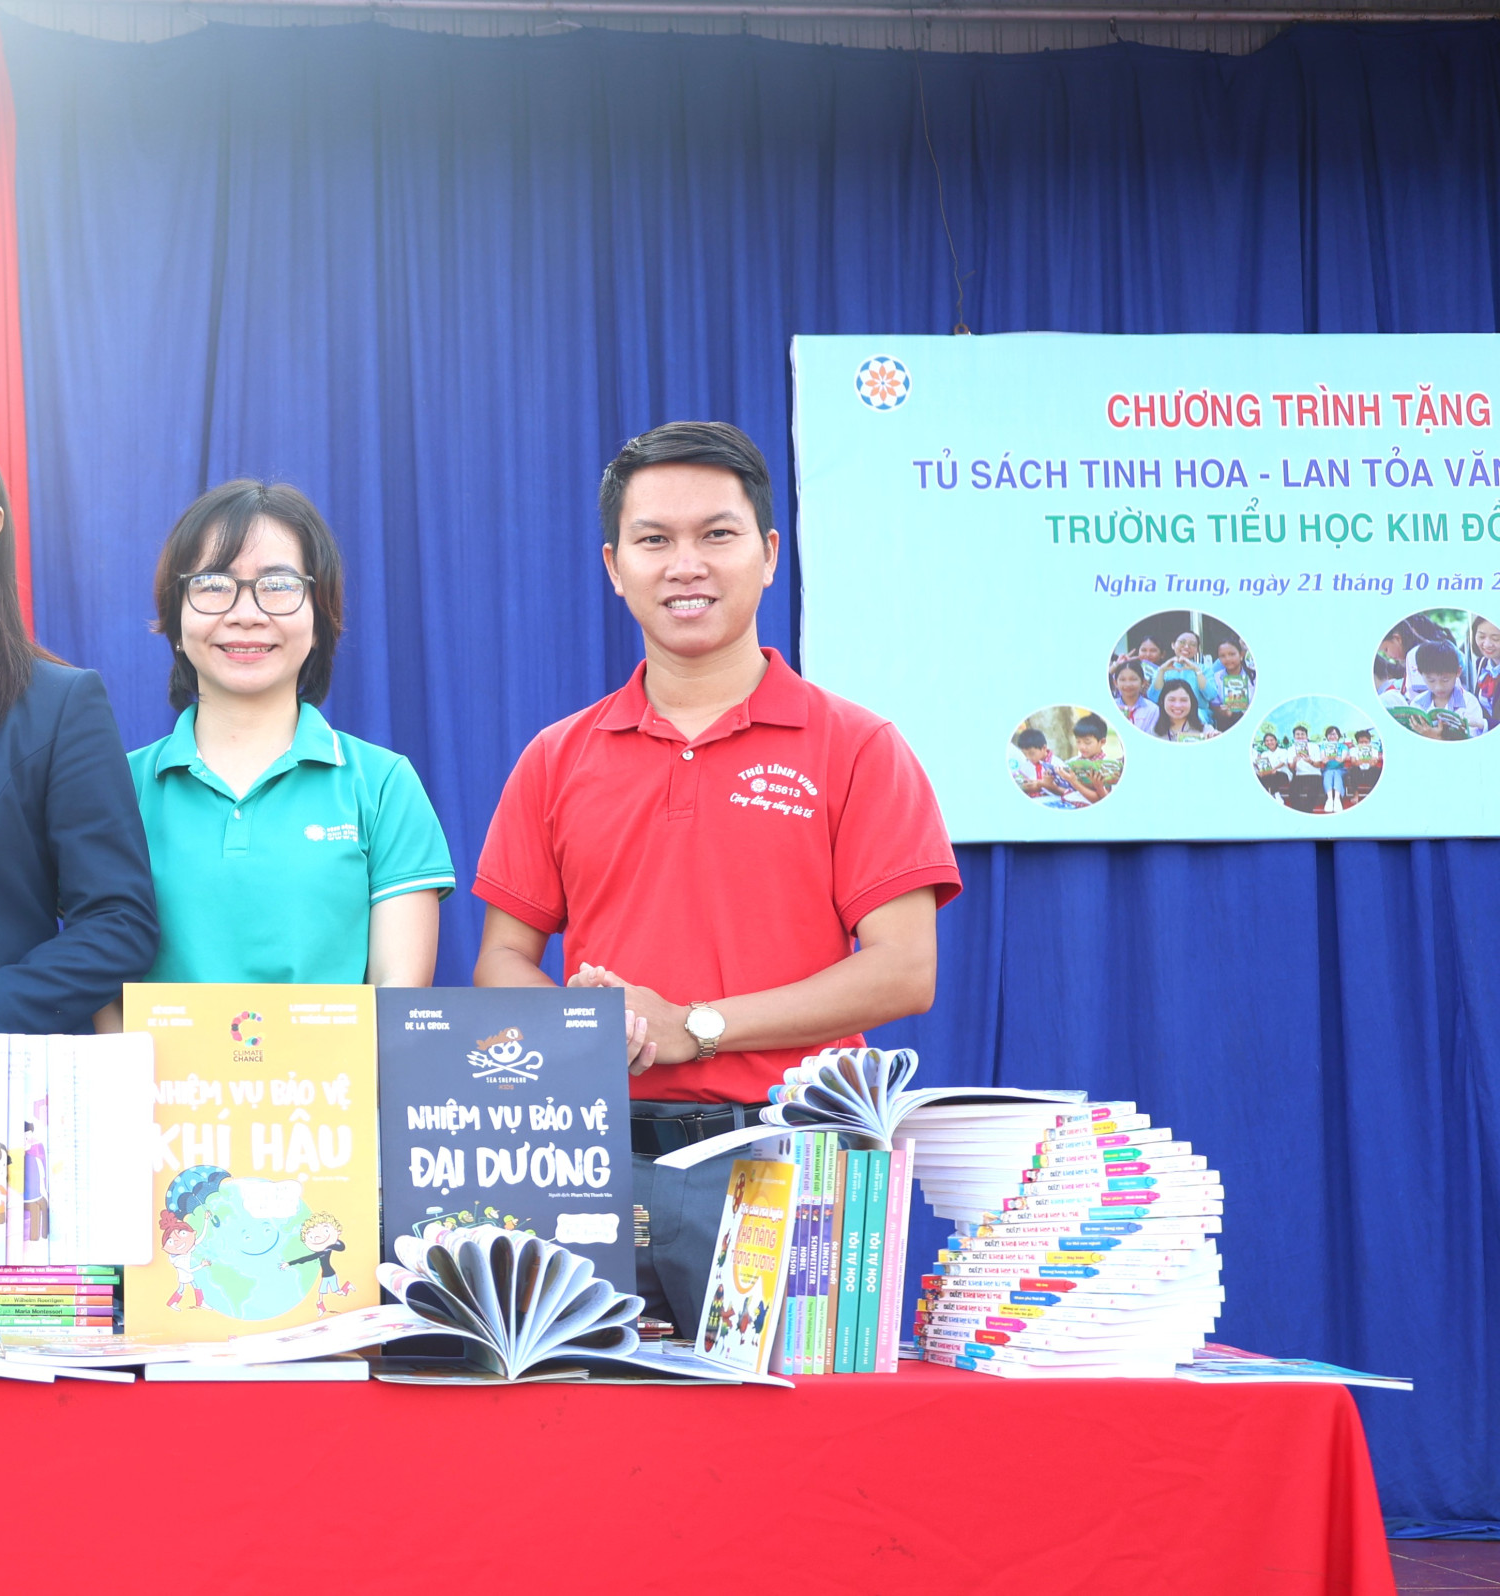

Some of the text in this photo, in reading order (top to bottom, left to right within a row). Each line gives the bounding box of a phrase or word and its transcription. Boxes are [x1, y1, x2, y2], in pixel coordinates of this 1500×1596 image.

[1108, 384, 1491, 434] CHƯƠNG TRÌNH TẶNG
[912, 448, 958, 489] TỦ
[971, 451, 1068, 489] SÁCH
[1080, 460, 1161, 489] TINH
[1175, 459, 1248, 488] HOA
[1282, 459, 1350, 487] LAN
[1362, 446, 1434, 488] TỎA
[1444, 450, 1500, 487] VĂ
[1045, 506, 1195, 544] TRƯỜNG
[1207, 497, 1287, 543] TIỂU
[1300, 513, 1373, 549] HỌC
[1388, 513, 1449, 542] KIM
[1094, 574, 1157, 597] Nghĩa
[1166, 574, 1231, 597] Trung,
[1239, 573, 1290, 597] ngày
[1299, 573, 1323, 591] 21
[1332, 573, 1394, 596] tháng
[1404, 573, 1429, 591] 10
[1437, 573, 1483, 591] năm
[737, 763, 765, 781] THỦ
[767, 763, 797, 779] LĨNH
[768, 783, 801, 798] 55613
[729, 792, 815, 819] Cộng đồng sống tử tế
[405, 1021, 450, 1031] DE LA CROIX
[409, 1008, 443, 1019] SÉVERINE
[563, 1008, 596, 1017] LAURENT
[565, 1019, 598, 1028] AUDOUIN
[153, 1070, 352, 1111] NHIỆM VỤ BẢO VỆ
[486, 1076, 497, 1084] SEA
[407, 1096, 609, 1136] NHIỆM VỤ BẢO VỆ
[153, 1107, 352, 1182] KHÍ HẬU
[409, 1141, 612, 1196] ĐẠI DƯƠNG
[799, 1246, 807, 1272] NOBEL
[809, 1235, 818, 1285] SCHWEITZER
[821, 1242, 830, 1276] LINCOLN
[831, 1241, 839, 1250] ÓC
[789, 1246, 798, 1275] EDISON
[844, 1231, 860, 1293] TÔI TỰ HỌC
[865, 1231, 881, 1293] TÔI TỰ HỌC
